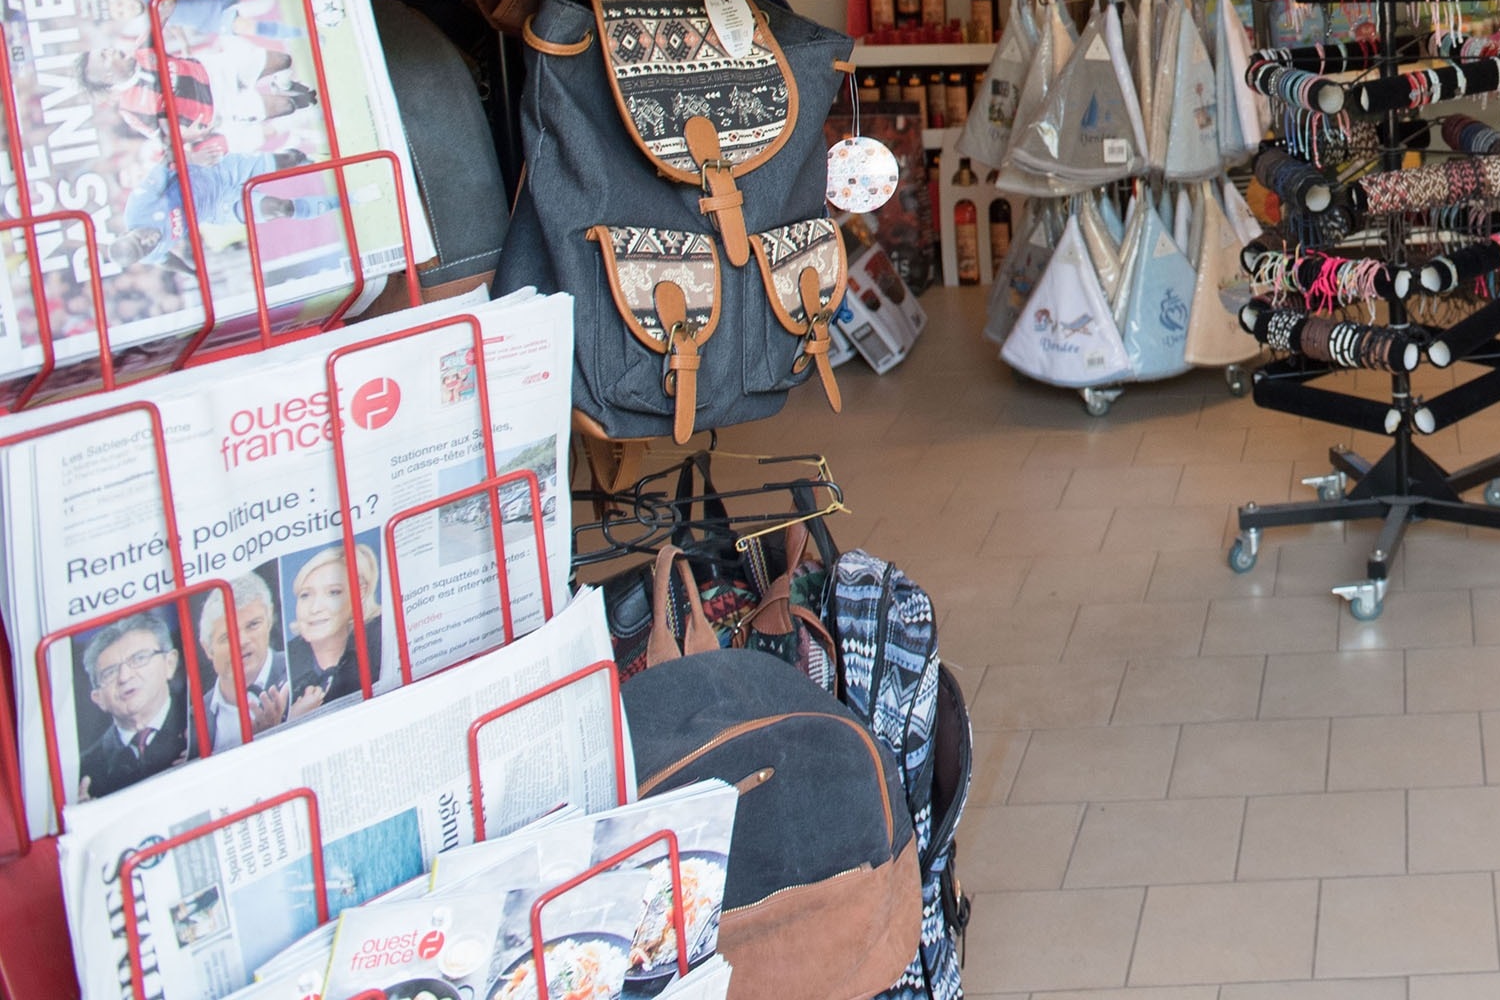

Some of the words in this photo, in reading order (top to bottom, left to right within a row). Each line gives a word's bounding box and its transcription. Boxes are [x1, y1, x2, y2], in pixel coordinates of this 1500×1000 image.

[219, 416, 346, 473] france
[390, 440, 449, 467] Stationner
[450, 434, 470, 447] aux
[192, 489, 301, 550] politique
[68, 580, 137, 617] avec
[437, 589, 456, 599] est
[437, 791, 461, 854] huge
[221, 844, 241, 884] Spain
[241, 850, 257, 875] cell
[259, 852, 272, 867] to
[362, 929, 419, 955] ouest
[351, 946, 415, 972] france
